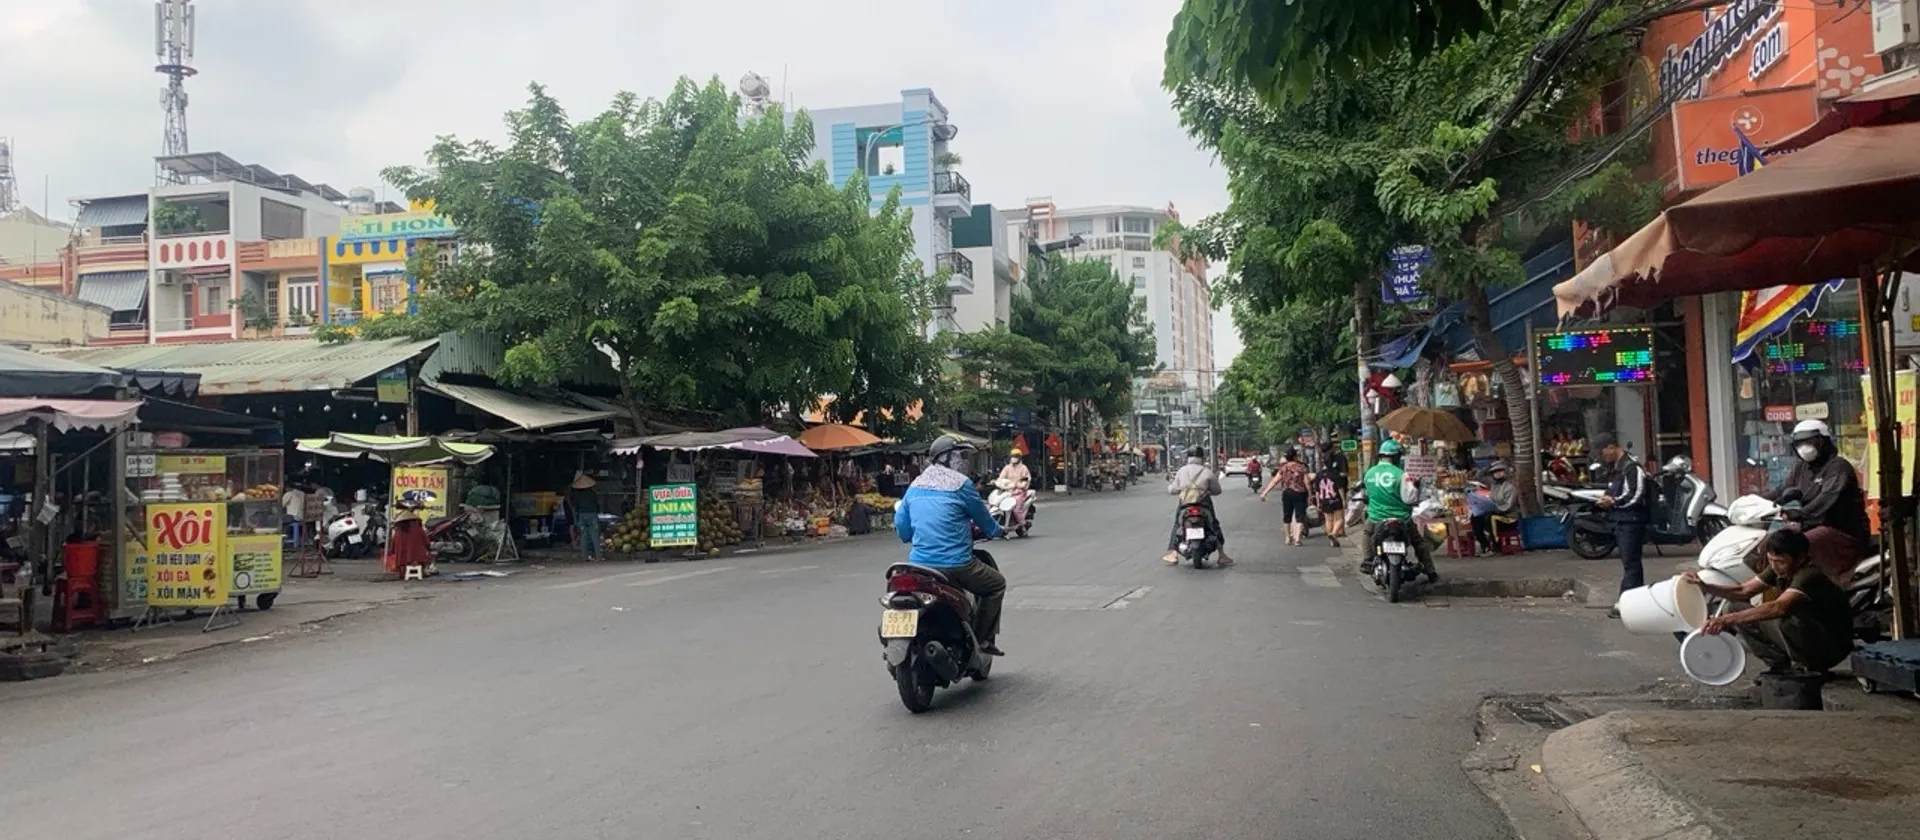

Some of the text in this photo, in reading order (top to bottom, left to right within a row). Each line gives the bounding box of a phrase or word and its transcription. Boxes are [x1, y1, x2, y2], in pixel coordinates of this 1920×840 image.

[391, 217, 444, 232] HON
[152, 509, 213, 550] Xôi
[156, 569, 174, 582] XÔI
[156, 585, 174, 599] XÔI
